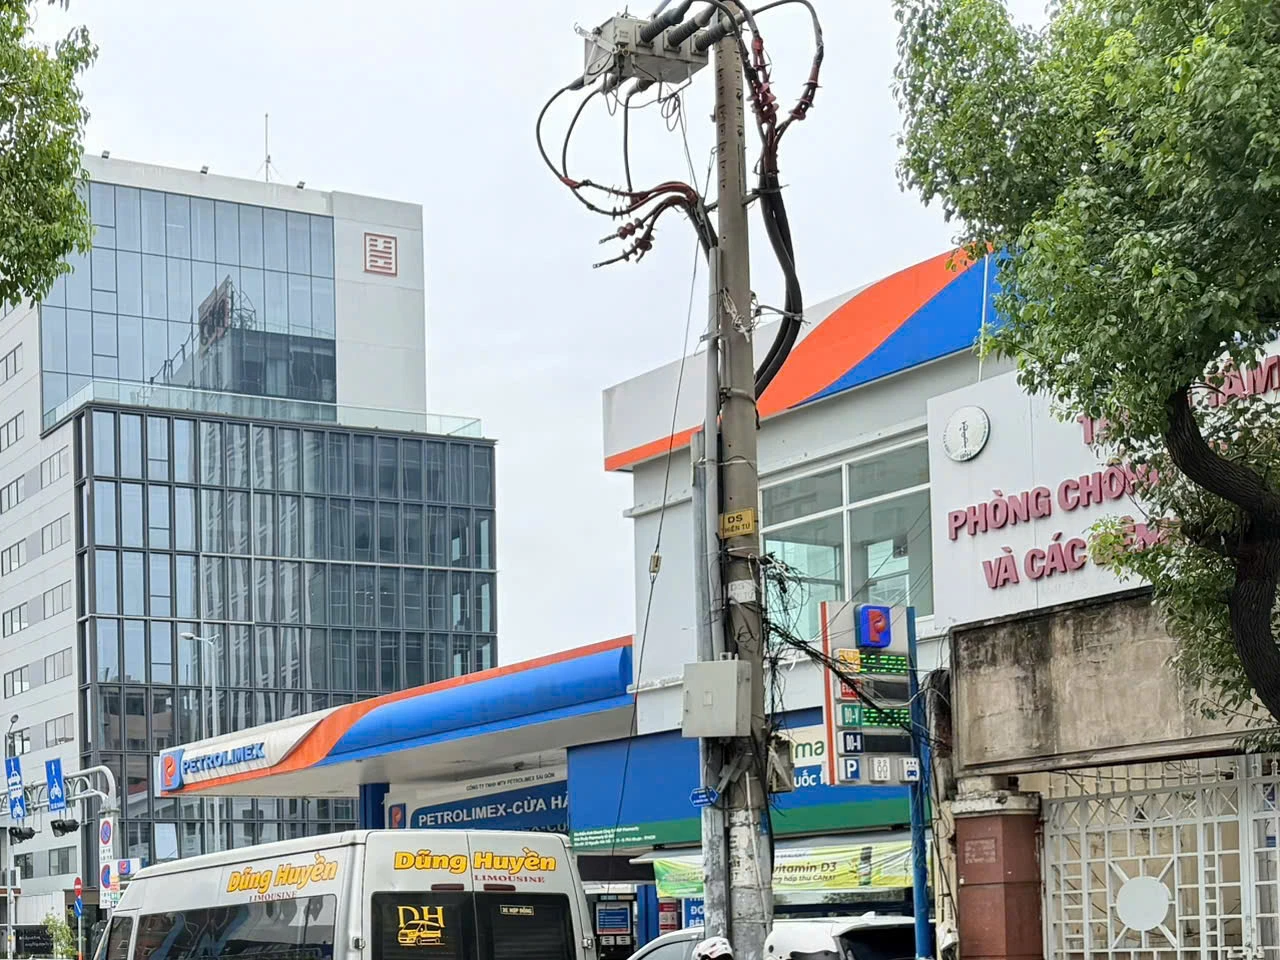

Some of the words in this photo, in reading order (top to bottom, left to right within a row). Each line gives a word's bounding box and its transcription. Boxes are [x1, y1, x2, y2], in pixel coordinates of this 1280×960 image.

[727, 514, 743, 524] DS
[948, 487, 1053, 541] PHÒNG
[982, 546, 1019, 589] VÀ
[1023, 532, 1087, 580] CÁC
[183, 742, 265, 774] PETROLIMEX
[846, 759, 857, 780] P
[394, 848, 468, 874] Dũng
[473, 846, 557, 874] Huyền
[820, 861, 837, 873] D3
[226, 866, 273, 894] Dũng
[273, 851, 339, 890] Huyền
[474, 874, 545, 884] LIMOUSINE
[249, 890, 297, 902] LIMOUSINE
[398, 905, 446, 928] DH
